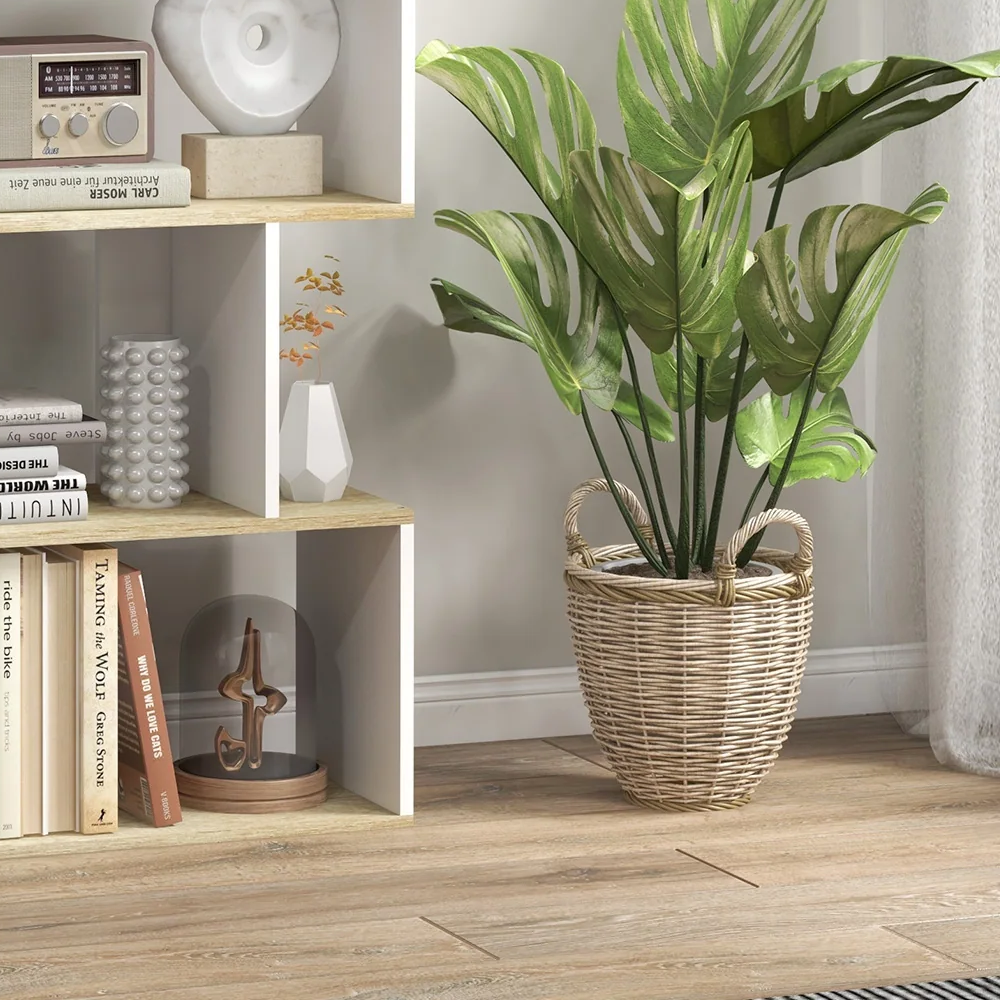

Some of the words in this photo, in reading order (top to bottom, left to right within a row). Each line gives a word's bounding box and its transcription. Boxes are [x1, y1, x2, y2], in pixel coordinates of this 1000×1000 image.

[9, 179, 29, 190] Zeit
[33, 178, 57, 188] neue
[60, 178, 81, 188] eine
[85, 177, 99, 188] für
[103, 175, 159, 187] Architektur
[90, 188, 127, 199] MOSER
[132, 187, 159, 198] CARL
[48, 412, 66, 420] The
[7, 431, 21, 444] by
[29, 431, 57, 443] Jobs
[65, 429, 101, 441] Steve
[28, 459, 48, 470] THE
[52, 478, 79, 490] THE
[3, 580, 13, 610] ride
[95, 559, 109, 626] TAMING
[3, 616, 13, 641] the
[95, 632, 106, 650] the
[3, 646, 13, 679] bike
[137, 655, 149, 677] WHY
[95, 652, 109, 700] WOLF
[141, 678, 152, 692] DO
[3, 691, 11, 707] tips
[143, 694, 154, 710] WE
[96, 712, 107, 746] GREG
[145, 710, 158, 734] LOVE
[150, 735, 162, 759] CATS
[96, 748, 107, 787] STONE
